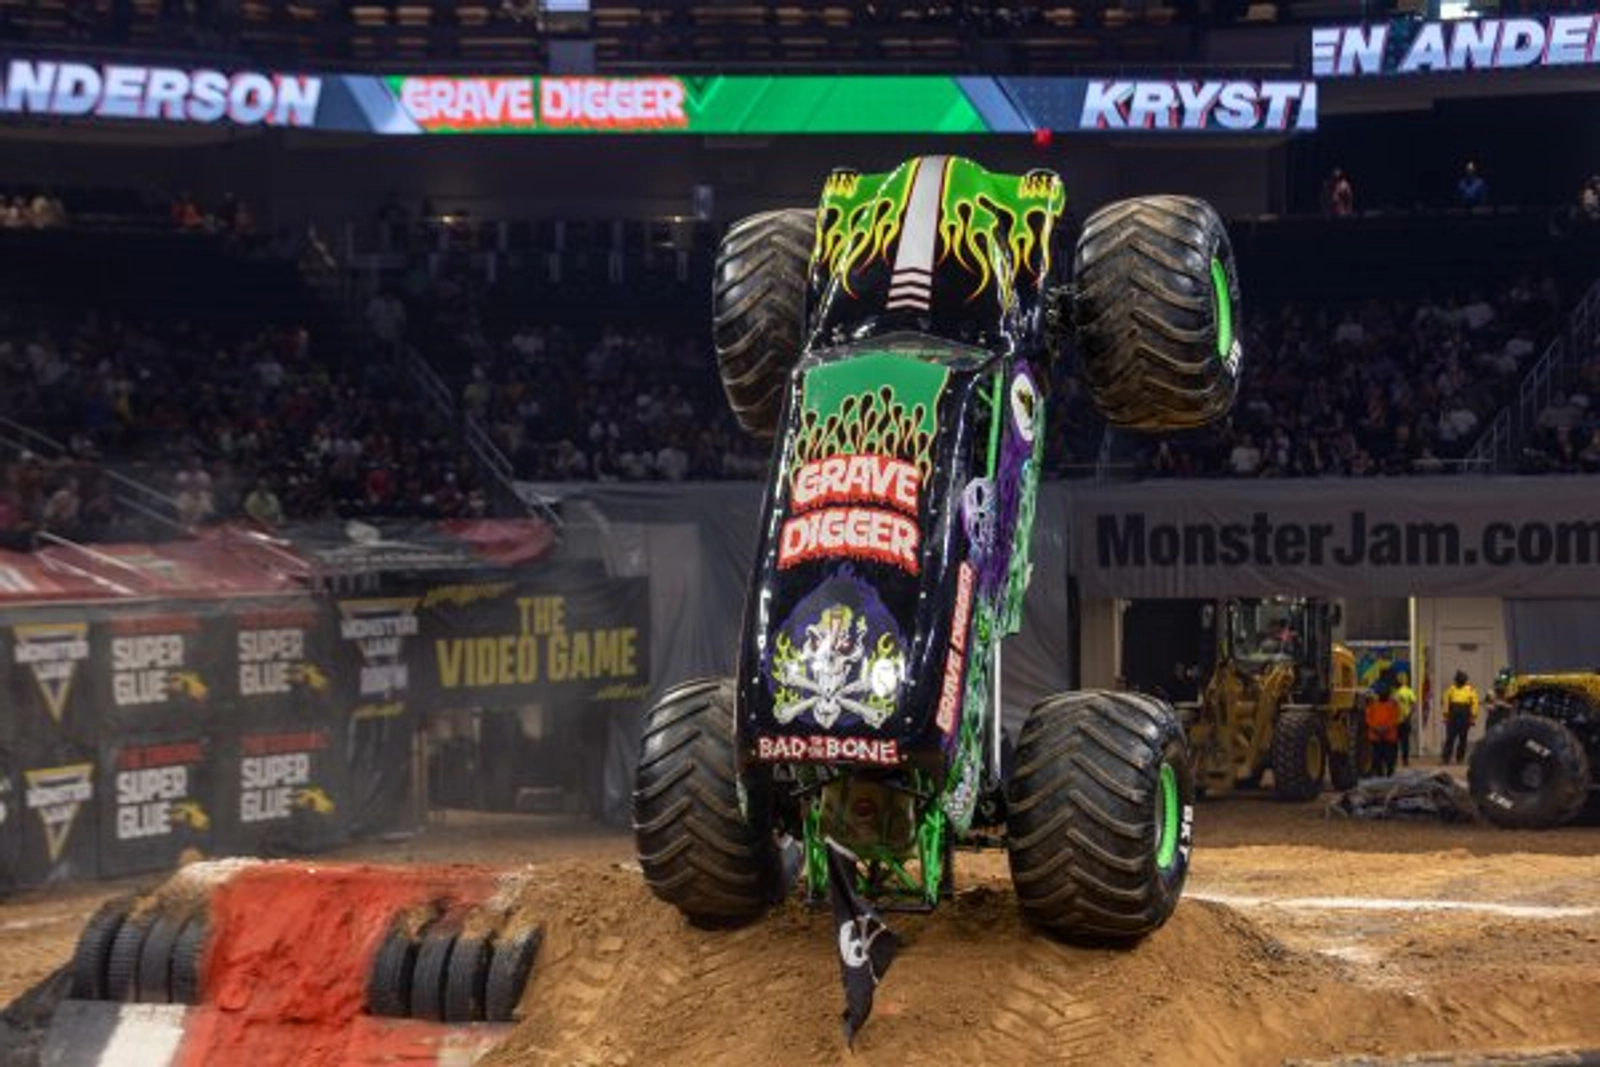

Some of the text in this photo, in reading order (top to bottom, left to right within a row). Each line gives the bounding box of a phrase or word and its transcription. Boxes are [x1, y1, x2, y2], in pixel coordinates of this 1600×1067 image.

[1400, 15, 1600, 72] ANDE
[0, 60, 321, 125] NDERSON
[402, 79, 687, 127] GRAVE DIGGER
[792, 456, 918, 505] GRAVE
[780, 510, 918, 566] DIGGER
[1098, 511, 1600, 567] MonsterJam.com
[517, 596, 566, 634] THE
[112, 635, 184, 670] SUPER
[239, 629, 303, 662] SUPER
[436, 635, 537, 687] VIDEO
[548, 630, 638, 682] GAME
[114, 670, 168, 704] GLUE
[241, 663, 291, 695] GLUE
[759, 736, 806, 759] BAD
[826, 736, 898, 764] BONE
[117, 767, 188, 803] SUPER
[241, 754, 309, 789] SUPER
[118, 802, 171, 839] GLUE
[241, 788, 292, 822] GLUE
